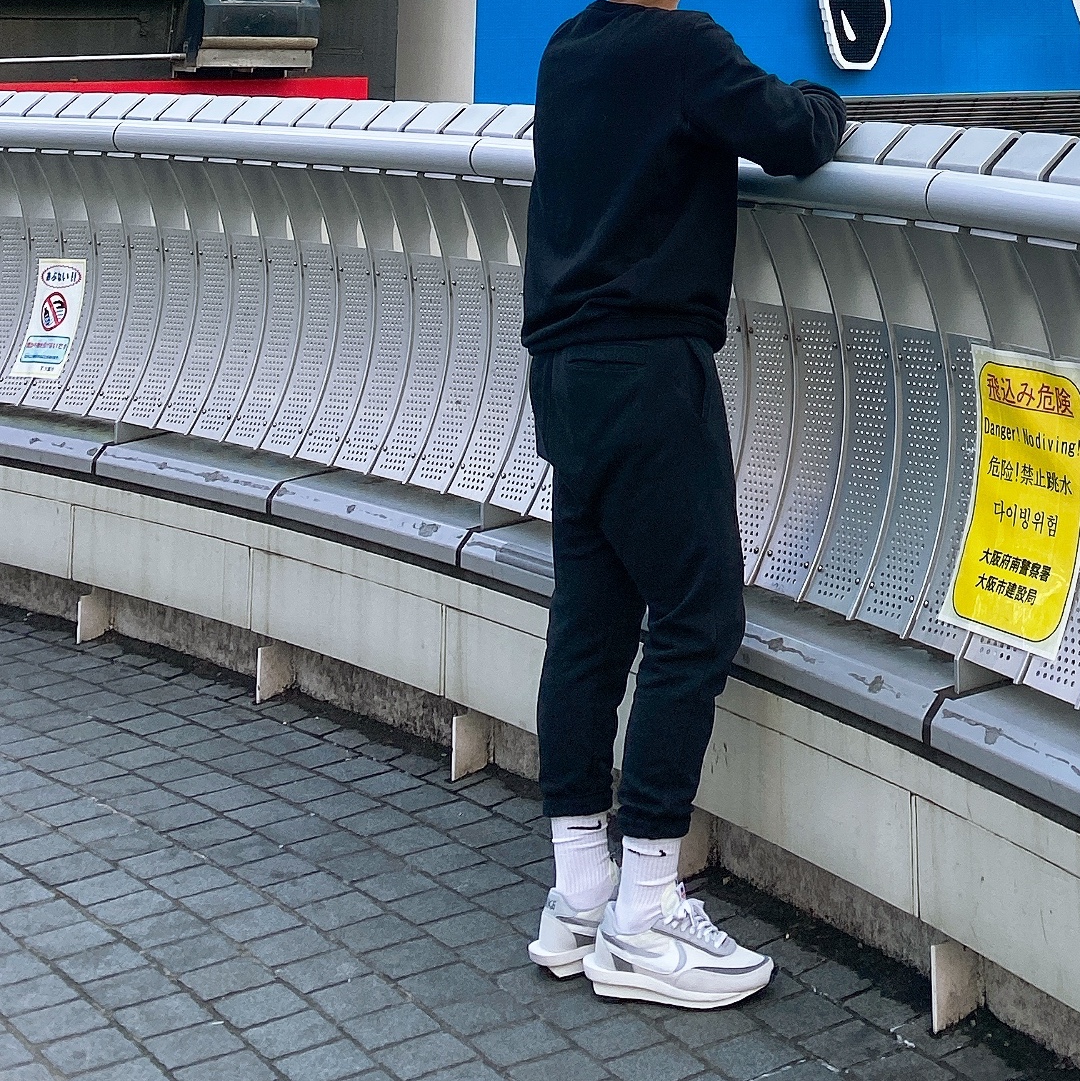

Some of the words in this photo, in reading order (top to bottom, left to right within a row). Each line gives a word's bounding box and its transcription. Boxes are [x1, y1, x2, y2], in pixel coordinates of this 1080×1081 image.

[986, 373, 1074, 416] 飛込み危険
[984, 417, 1020, 442] Danger!
[987, 454, 1073, 496] 危险!禁止跳水
[994, 500, 1059, 537] 다이빙위험
[979, 547, 1052, 583] 大阪府南警察署
[975, 572, 1037, 606] 大阪市建設局
